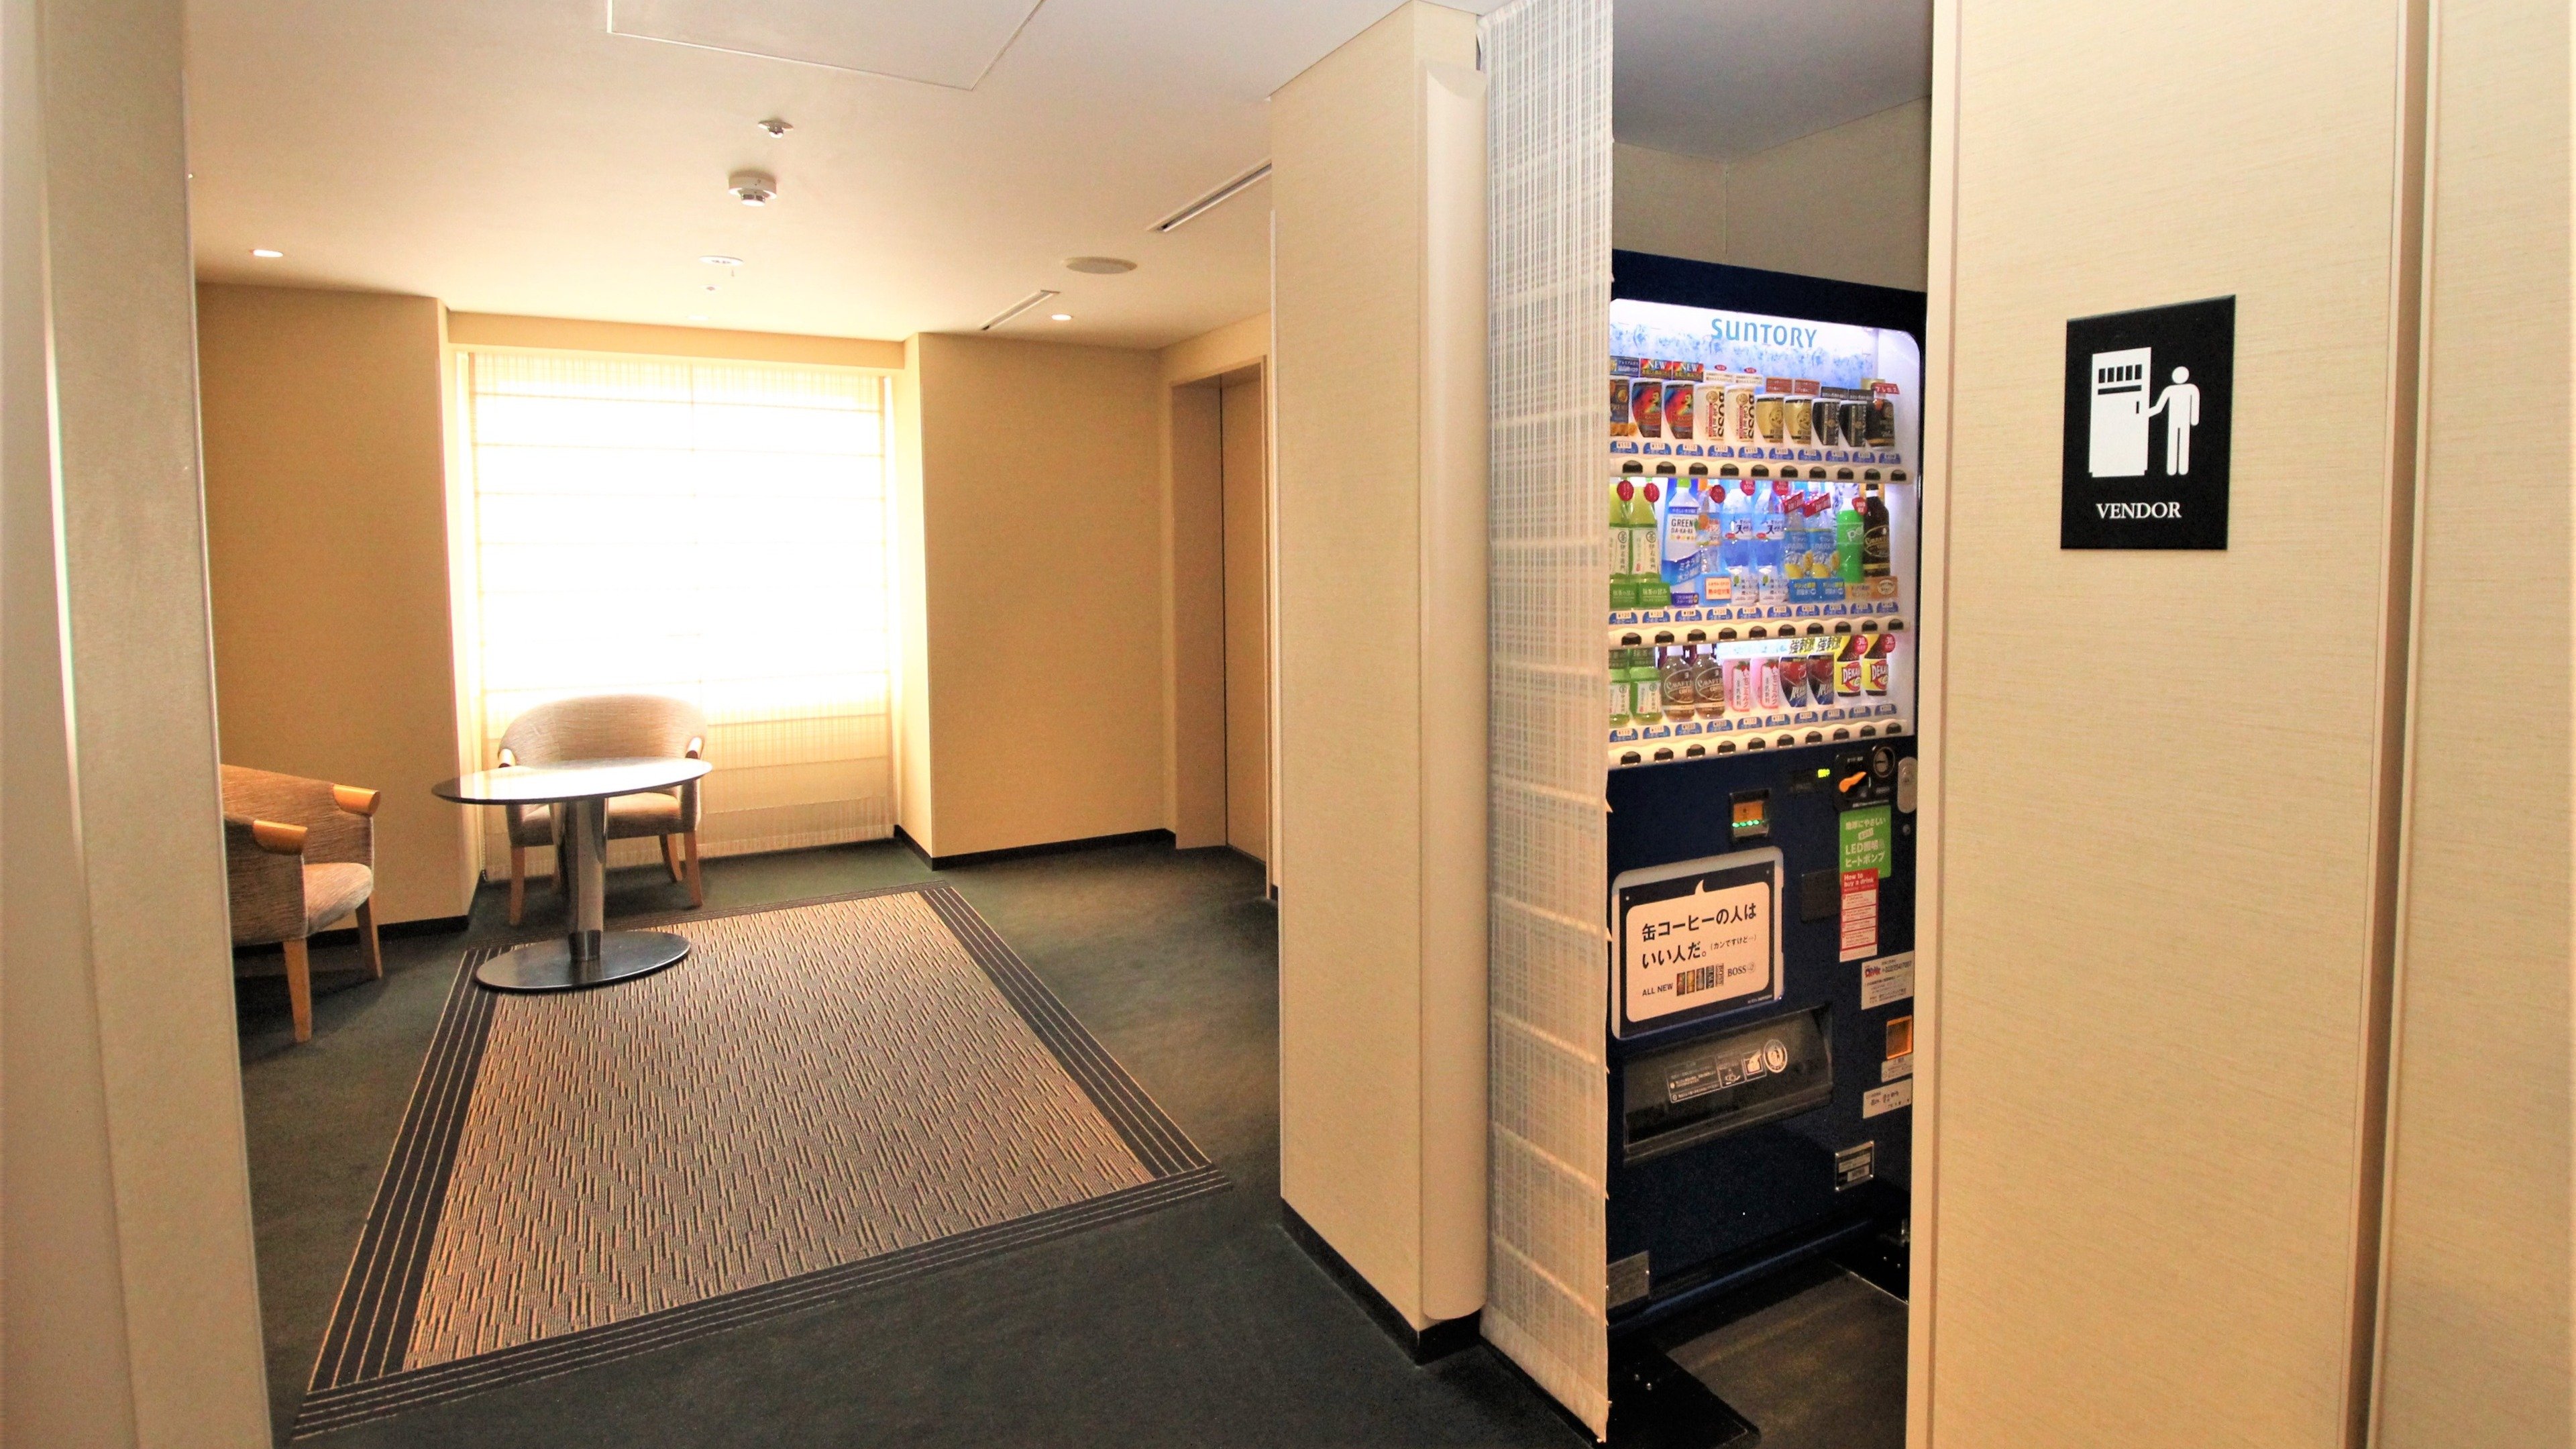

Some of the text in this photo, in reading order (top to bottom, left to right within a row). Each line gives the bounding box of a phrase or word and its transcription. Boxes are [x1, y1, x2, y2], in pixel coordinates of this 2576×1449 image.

[1711, 319, 1817, 347] SUNTORY
[1648, 360, 1666, 370] NEW
[1680, 363, 1699, 372] NEW
[2096, 502, 2182, 519] VENDOR
[1671, 519, 1693, 527] GREEN
[1860, 877, 1874, 885] drink
[1642, 903, 1756, 942] 缶コーヒーの人は
[1642, 941, 1707, 969] いい人だ。
[1727, 965, 1747, 977] BOSS
[1642, 983, 1674, 997] ALL NEW
